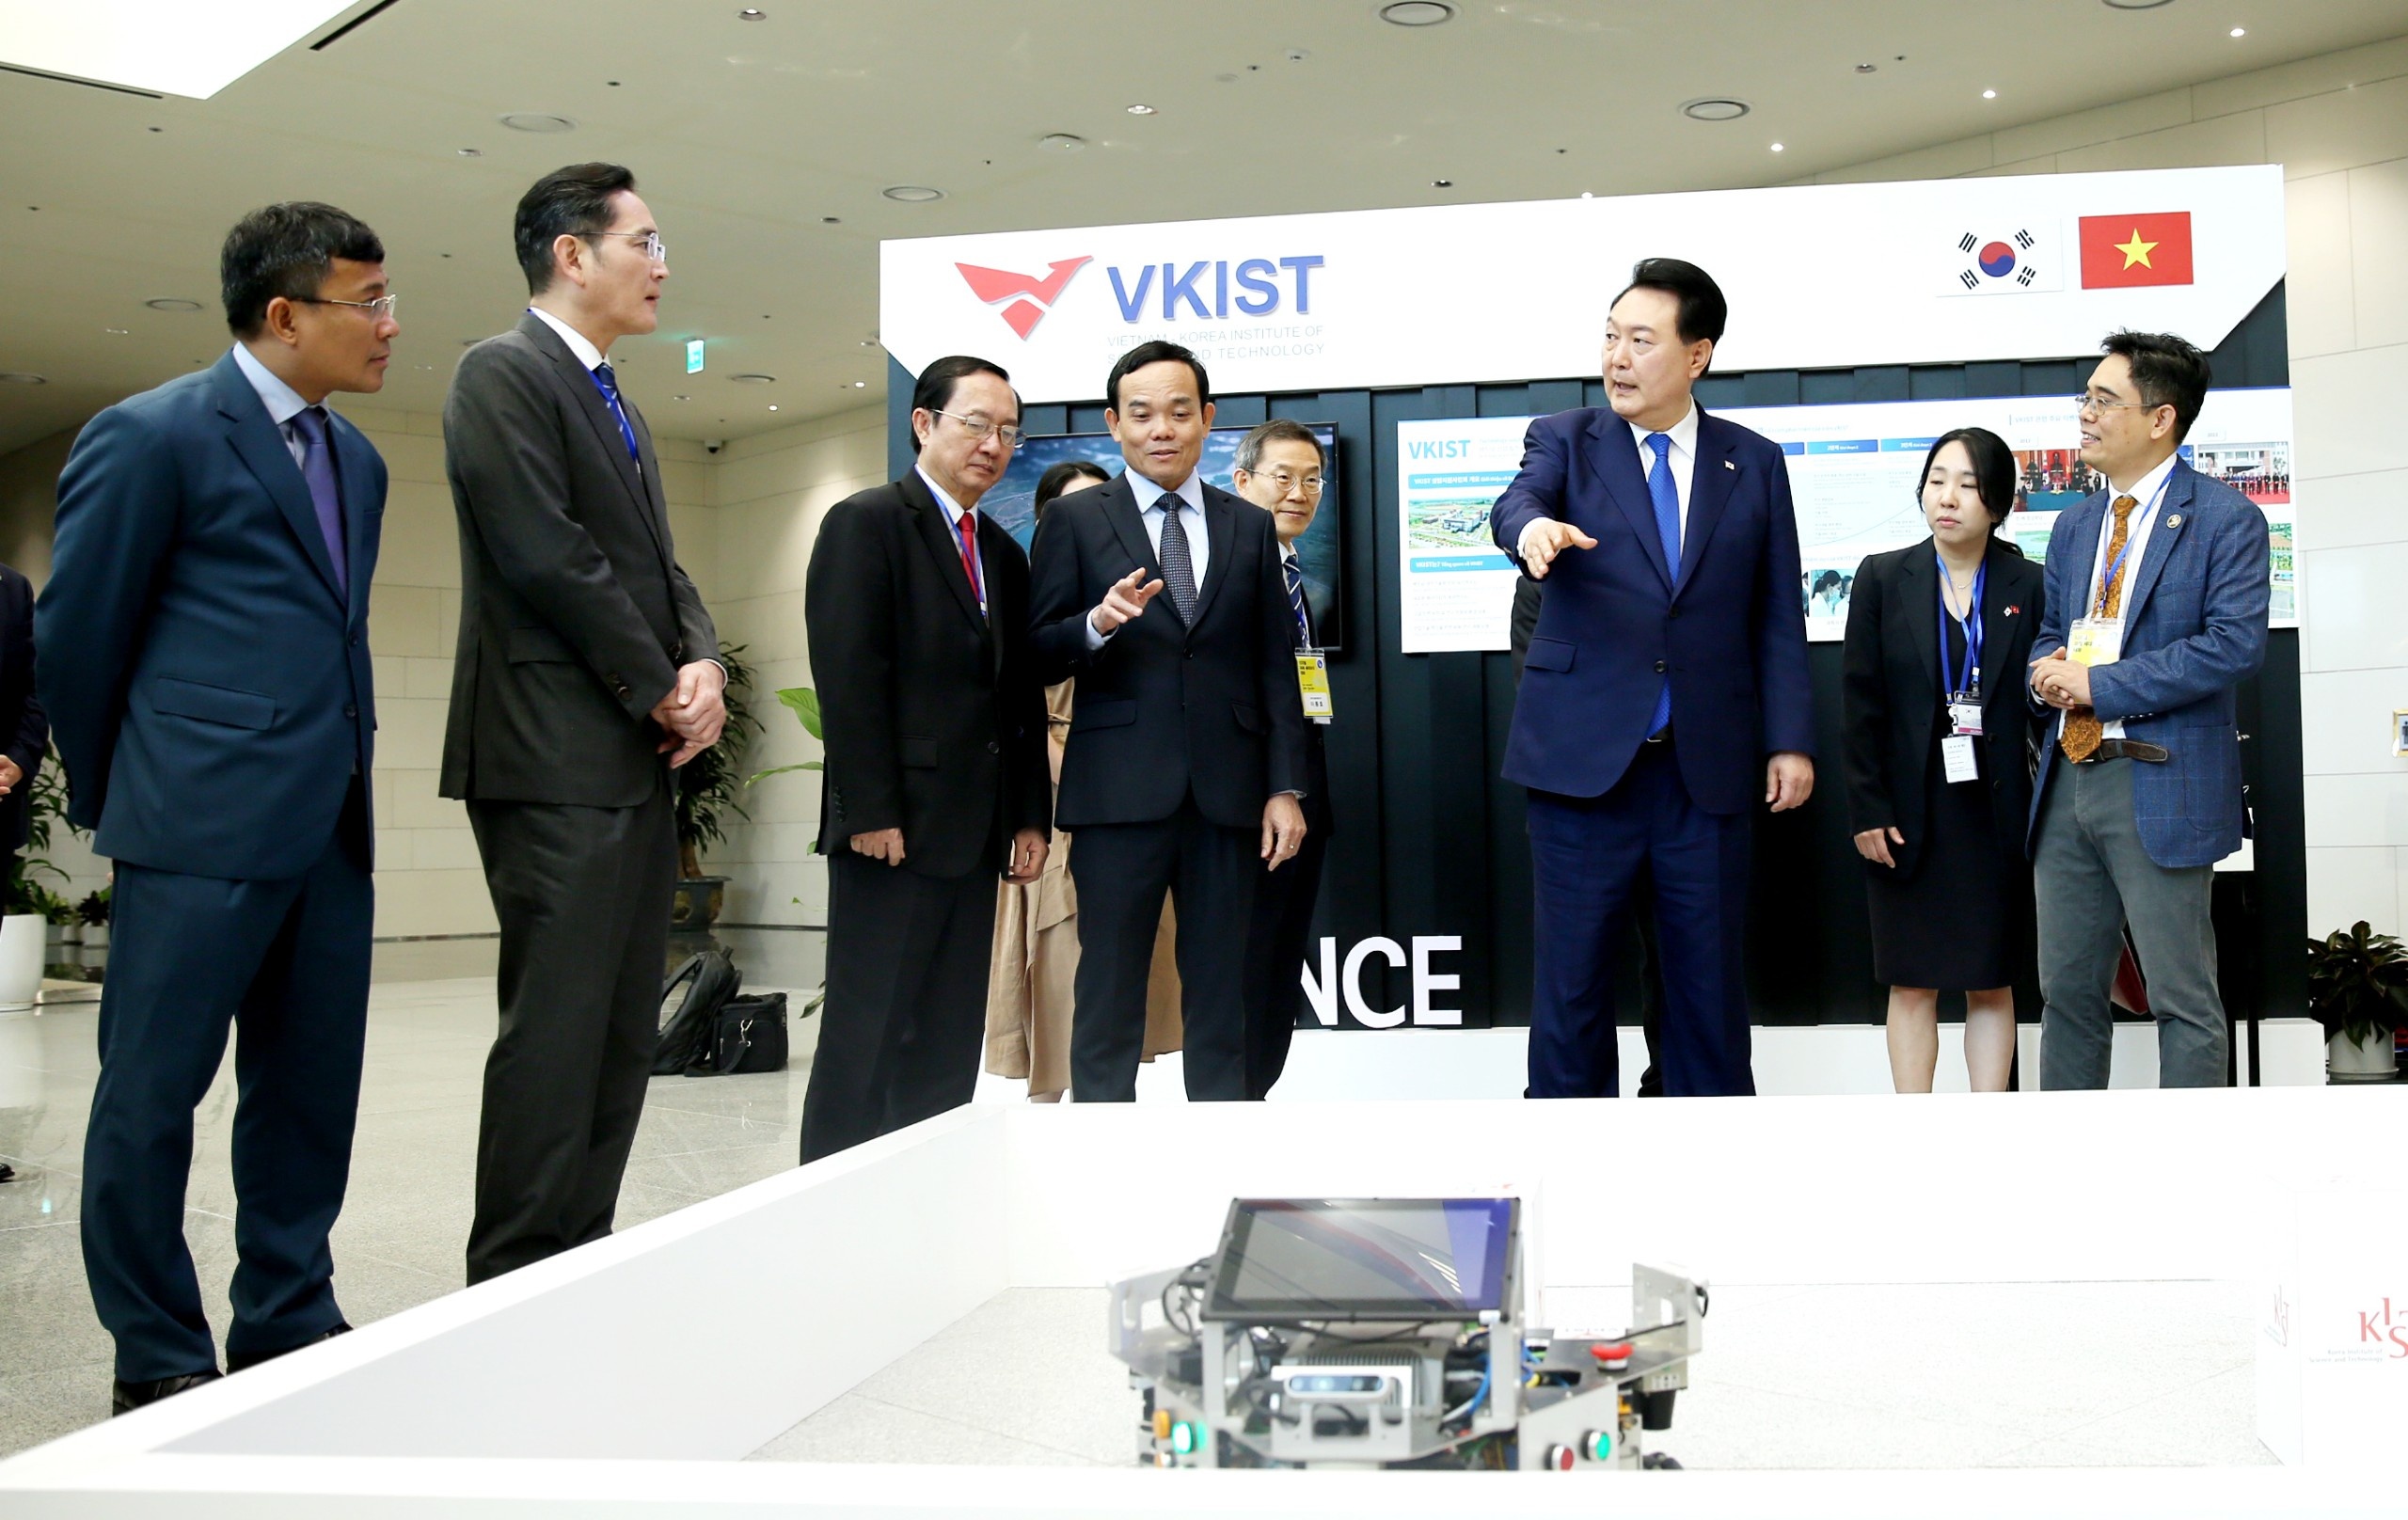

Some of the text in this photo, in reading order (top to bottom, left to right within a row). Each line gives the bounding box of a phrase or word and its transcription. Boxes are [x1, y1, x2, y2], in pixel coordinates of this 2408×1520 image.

[1107, 255, 1324, 324] VKIST
[1107, 333, 1167, 347] VIETNAM
[1180, 330, 1227, 343] KOREA
[1230, 326, 1300, 340] INSTITUTE
[1305, 325, 1324, 338] OF
[1191, 343, 1325, 360] ND TECHNOLOGY
[1408, 439, 1470, 459] VKIST
[1295, 935, 1463, 1029] NCE
[2357, 1297, 2408, 1359] KIS
